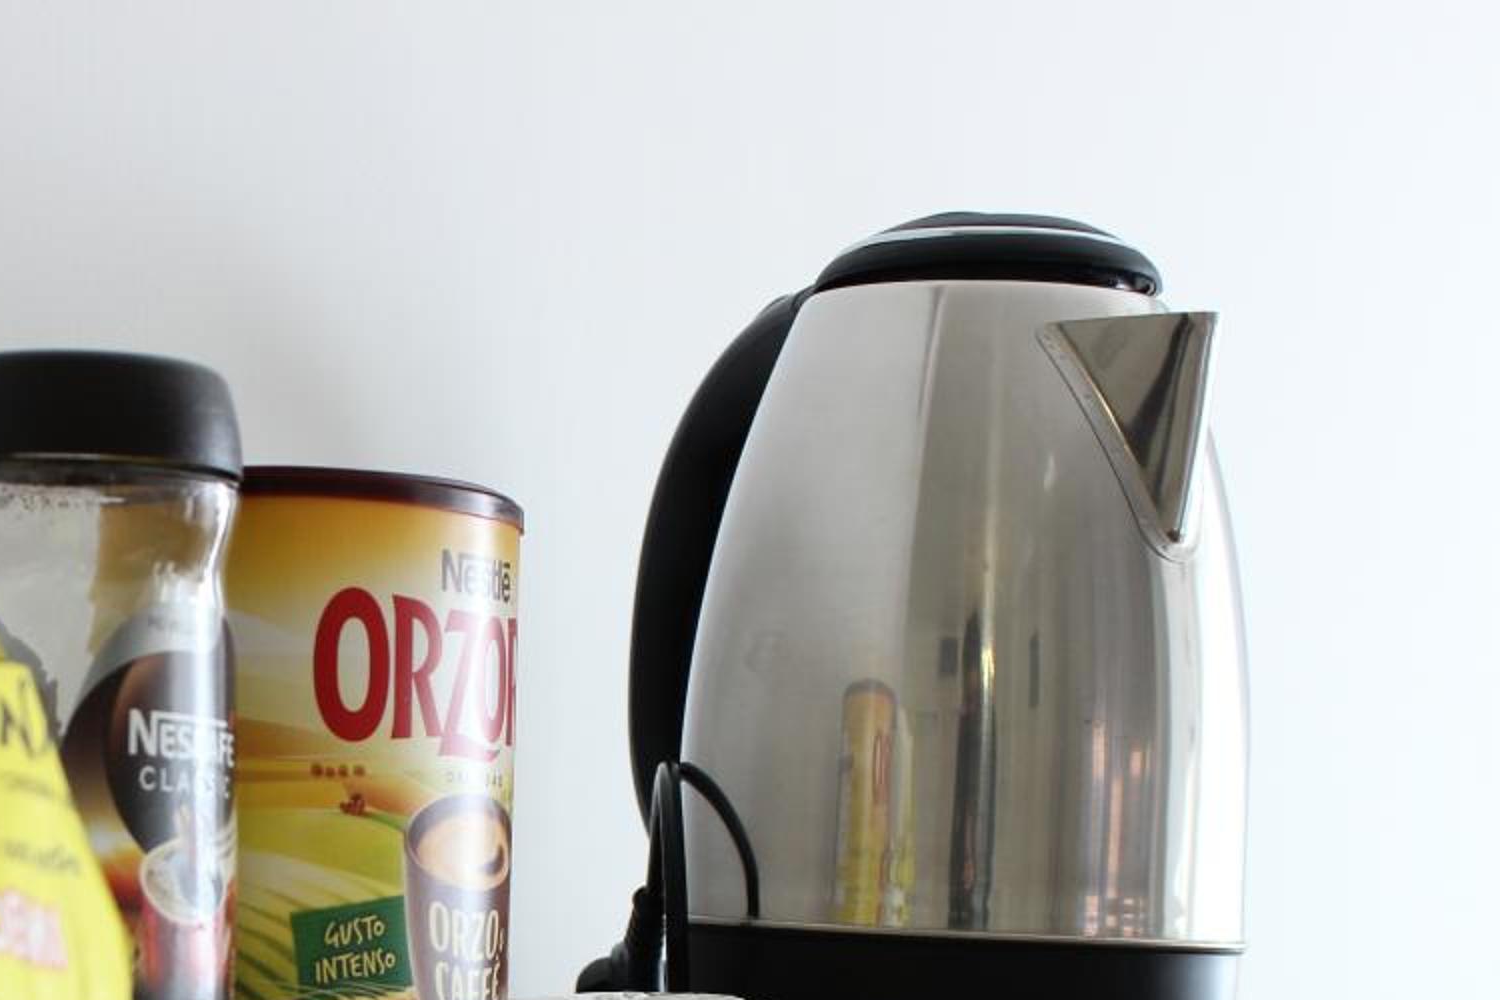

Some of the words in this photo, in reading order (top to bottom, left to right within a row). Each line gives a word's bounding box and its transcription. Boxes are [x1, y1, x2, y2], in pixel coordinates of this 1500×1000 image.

[441, 548, 511, 603] Netlé
[128, 707, 235, 768] NESFÉ
[138, 765, 232, 800] CLAS
[324, 914, 385, 948] GUSTO
[315, 947, 396, 984] INTENSO
